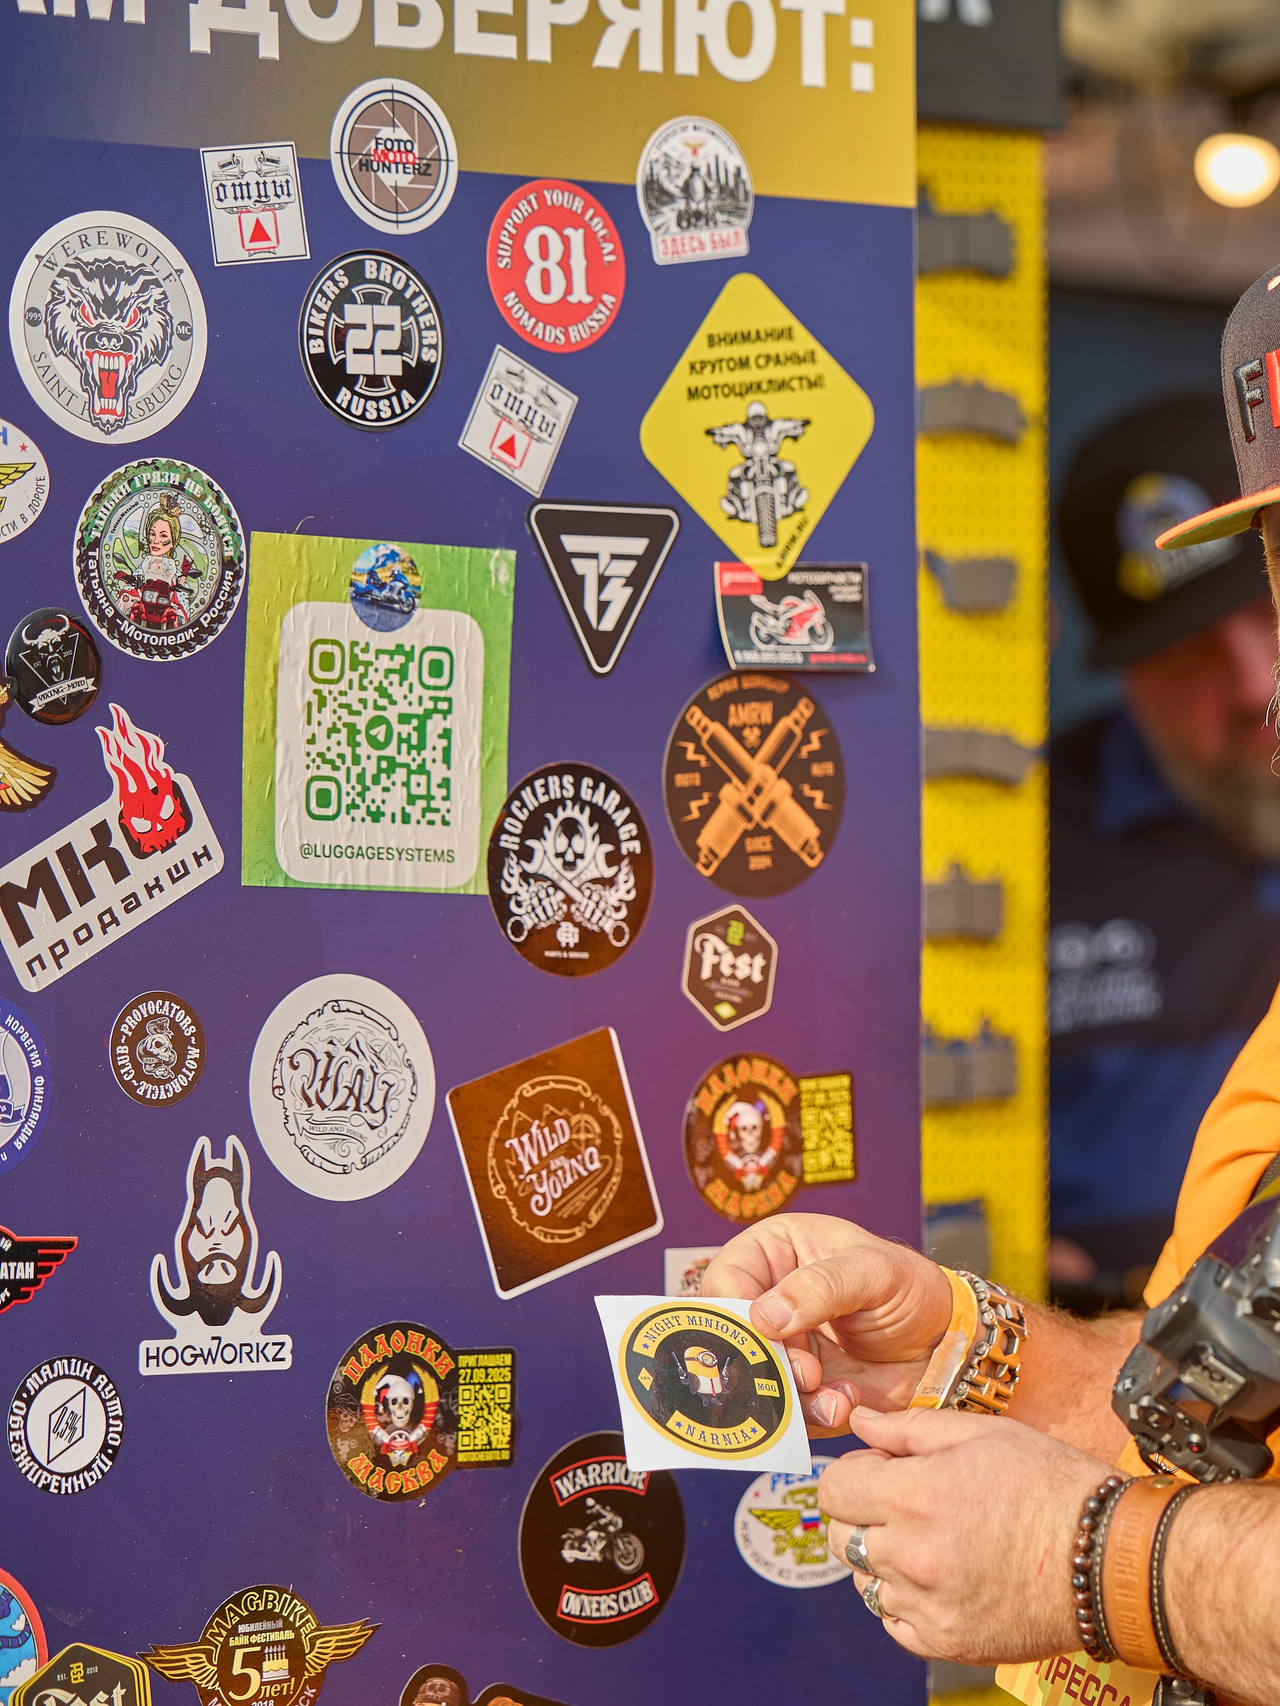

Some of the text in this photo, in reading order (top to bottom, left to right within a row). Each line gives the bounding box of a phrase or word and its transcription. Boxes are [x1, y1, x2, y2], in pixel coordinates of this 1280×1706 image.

[373, 149, 418, 166] MOTO
[374, 137, 415, 153] FOTO
[358, 158, 433, 177] HUNTERZ
[497, 189, 618, 271] SUPPORT YOUR LOCAL
[660, 230, 741, 259] ЗДЕСЬ БЫЛ
[42, 230, 178, 284] WEREWOLF
[523, 225, 595, 305] 81
[25, 311, 43, 322] 1995
[176, 325, 193, 336] MC
[308, 259, 438, 364] BIKERS BROTHERS
[502, 290, 618, 346] NOMADS RUSSIA
[344, 303, 403, 376] 22
[707, 326, 794, 348] ВНИМАНИЕ
[33, 351, 79, 407] SAINT
[689, 349, 818, 375] КРУГОМ СРАНЫЕ
[336, 386, 417, 421] RUSSIA
[686, 374, 825, 402] МОТОЦИКЛИСТЫ!
[28, 475, 46, 516] ДОРОГЕ
[134, 471, 181, 488] ГРЯЗИ
[184, 480, 204, 497] НЕ
[88, 547, 115, 618] Татьяна
[200, 570, 235, 627] Россия
[38, 679, 86, 702] VIKING-MOTO
[499, 774, 641, 856] ROCKERS GARAGE
[300, 843, 456, 863] @LUGGAGESYSTEMS
[25, 844, 214, 978] продакшн
[120, 1000, 197, 1037] PROVOCATORS
[5, 1014, 42, 1068] НОРВЕГИЯ
[116, 1045, 135, 1081] CLUB
[136, 1046, 200, 1100] MOTORCYCLE
[13, 1075, 45, 1151] ФИНЛЯНДИЯ
[643, 1315, 749, 1347] NIGHT MINIONS
[343, 1329, 455, 1386] ПАДОНКИ
[458, 1369, 511, 1384] 27.09.2025
[26, 1358, 123, 1447] МАМИН АУТЛО
[9, 1400, 113, 1494] ОБЕЗЖИРЕННЫЙ
[685, 1424, 752, 1447] NARNIA
[347, 1449, 449, 1495] МАСКВА
[554, 1461, 648, 1499] WARRIOR
[206, 1590, 317, 1645] MAGBIKE
[561, 1579, 654, 1618] OWNERS CLUB
[229, 1629, 295, 1646] БАЙК ФЕСТИВАЛЬ
[238, 1618, 284, 1633] ЮБИЛЕЙНЫЙ
[228, 1646, 262, 1701] 5
[258, 1677, 296, 1699] лет!
